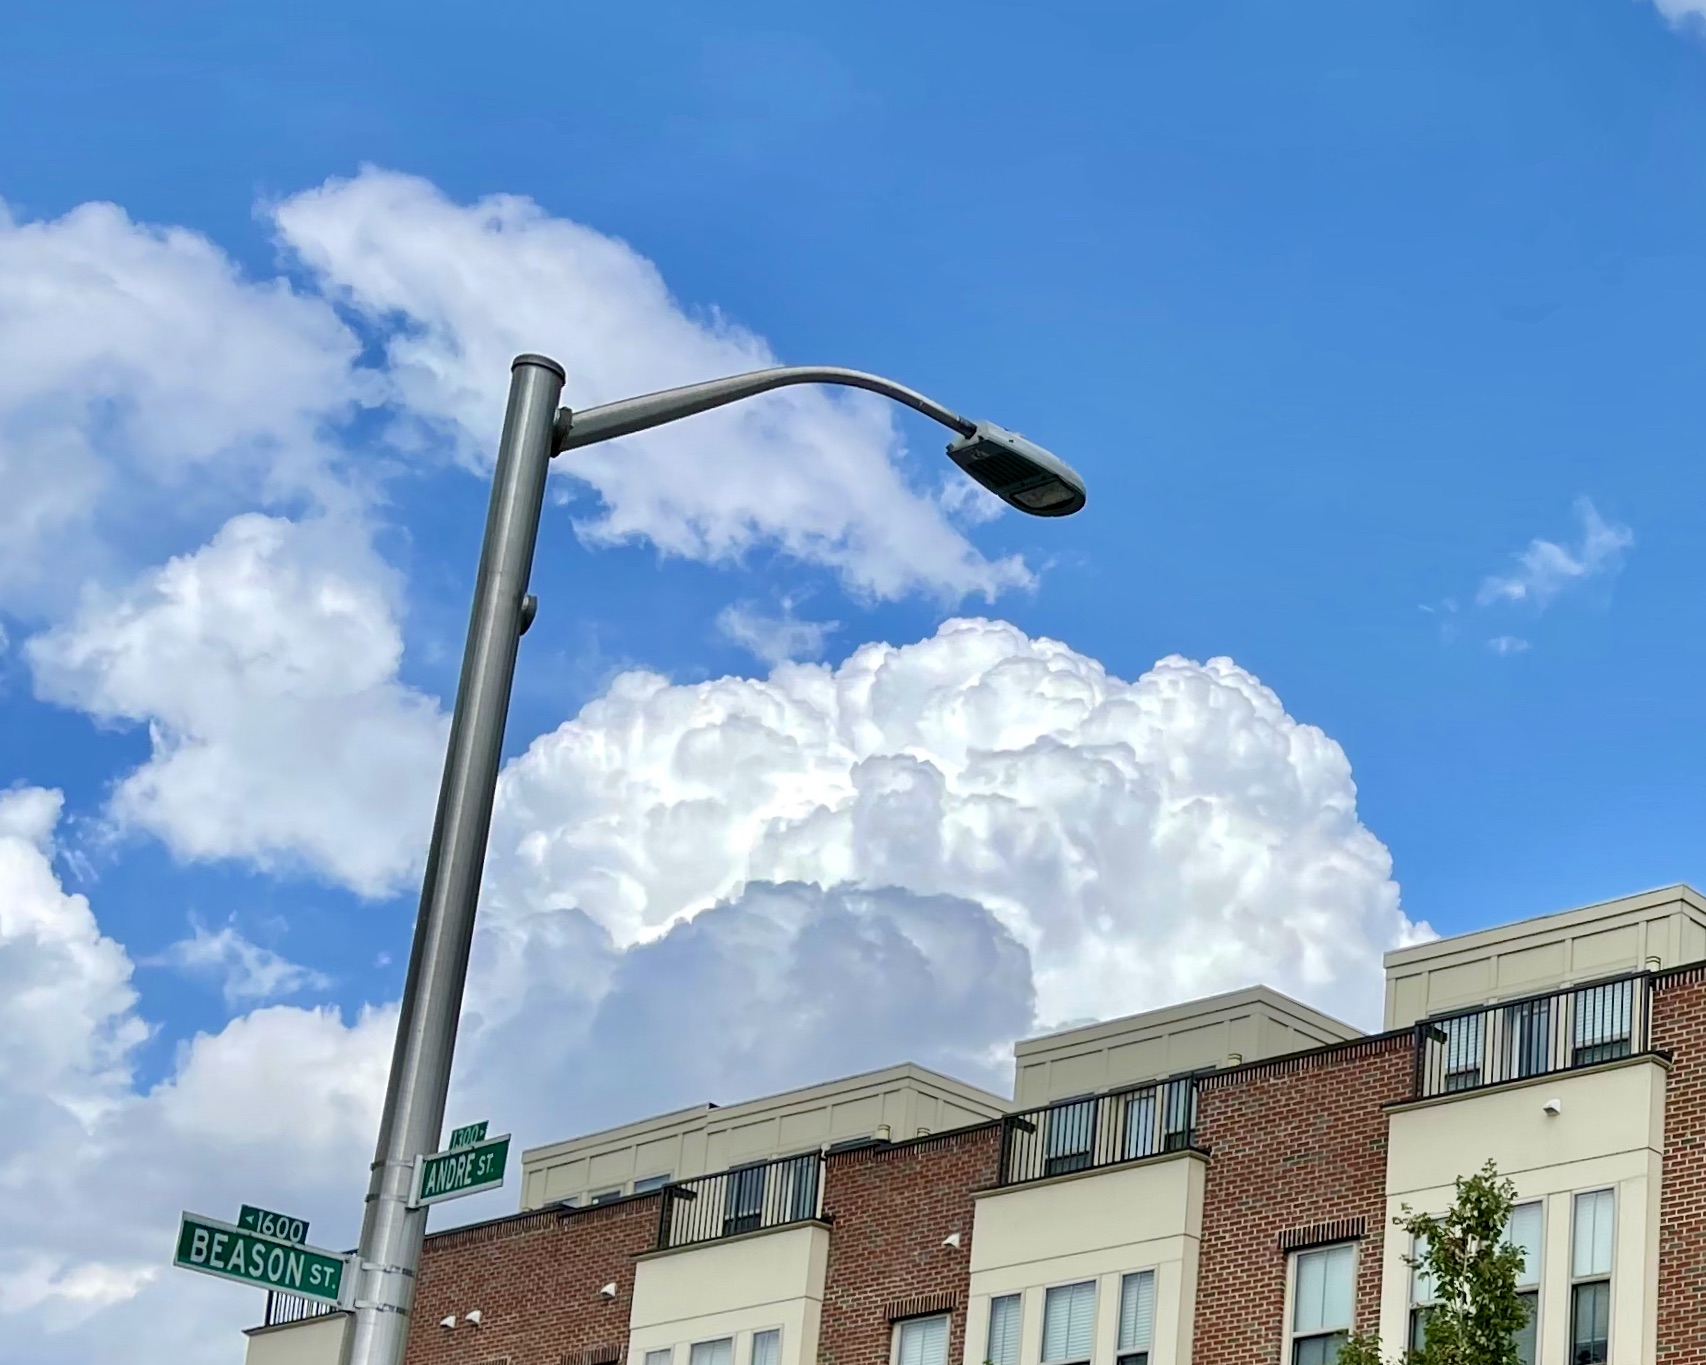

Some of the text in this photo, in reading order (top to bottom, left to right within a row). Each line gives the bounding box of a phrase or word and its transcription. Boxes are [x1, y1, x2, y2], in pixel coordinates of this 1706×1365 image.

[452, 1125, 479, 1148] 1300
[425, 1152, 494, 1195] ANDRE ST.
[256, 1210, 303, 1243] 1600
[190, 1227, 336, 1289] BEASON ST.
